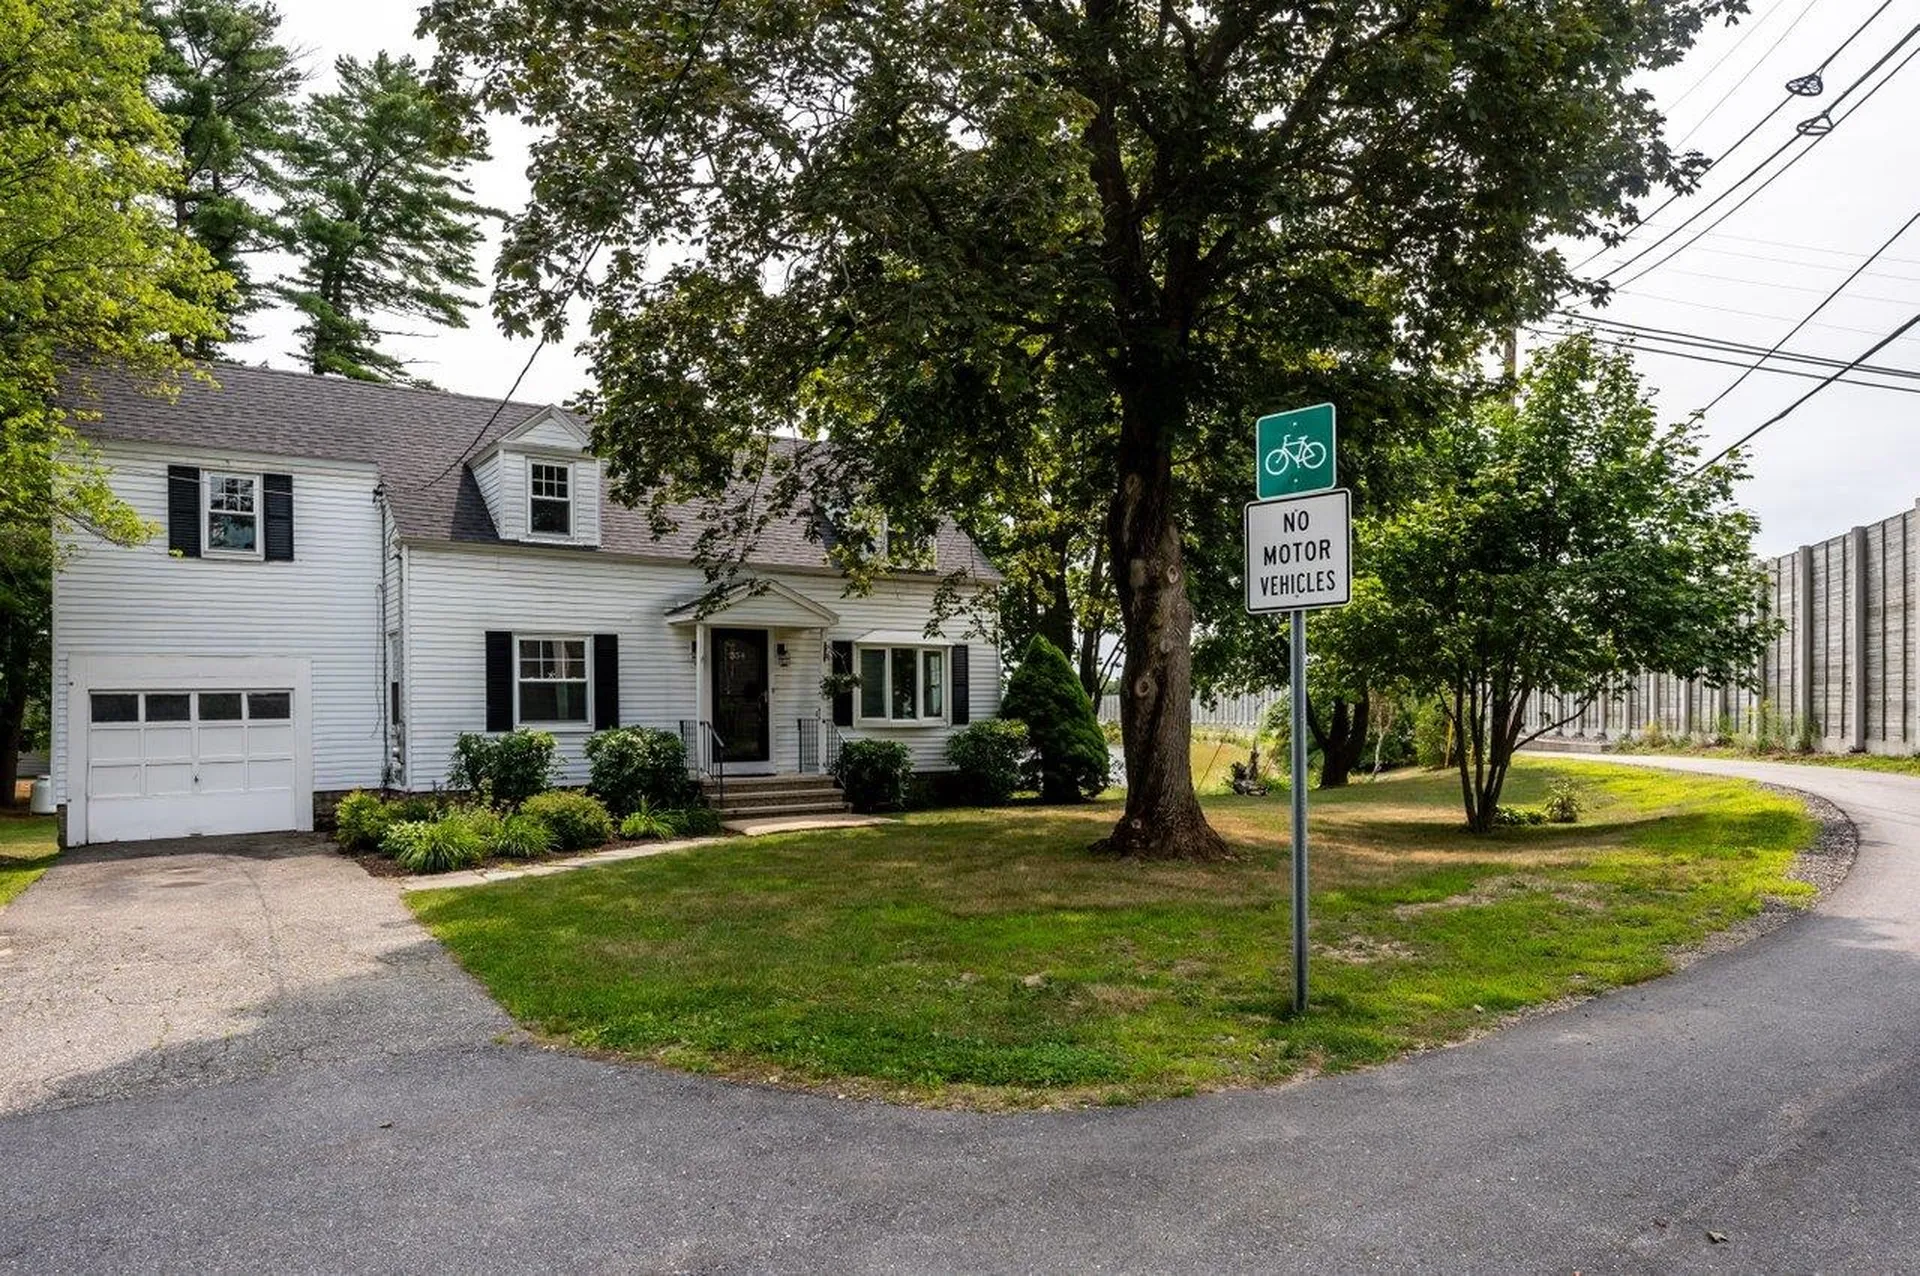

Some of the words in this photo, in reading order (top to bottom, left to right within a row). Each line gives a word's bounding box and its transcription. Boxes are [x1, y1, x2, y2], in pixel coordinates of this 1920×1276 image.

[1284, 511, 1309, 532] NO
[1264, 539, 1331, 566] MOTOR
[1261, 570, 1335, 596] VEHICLES
